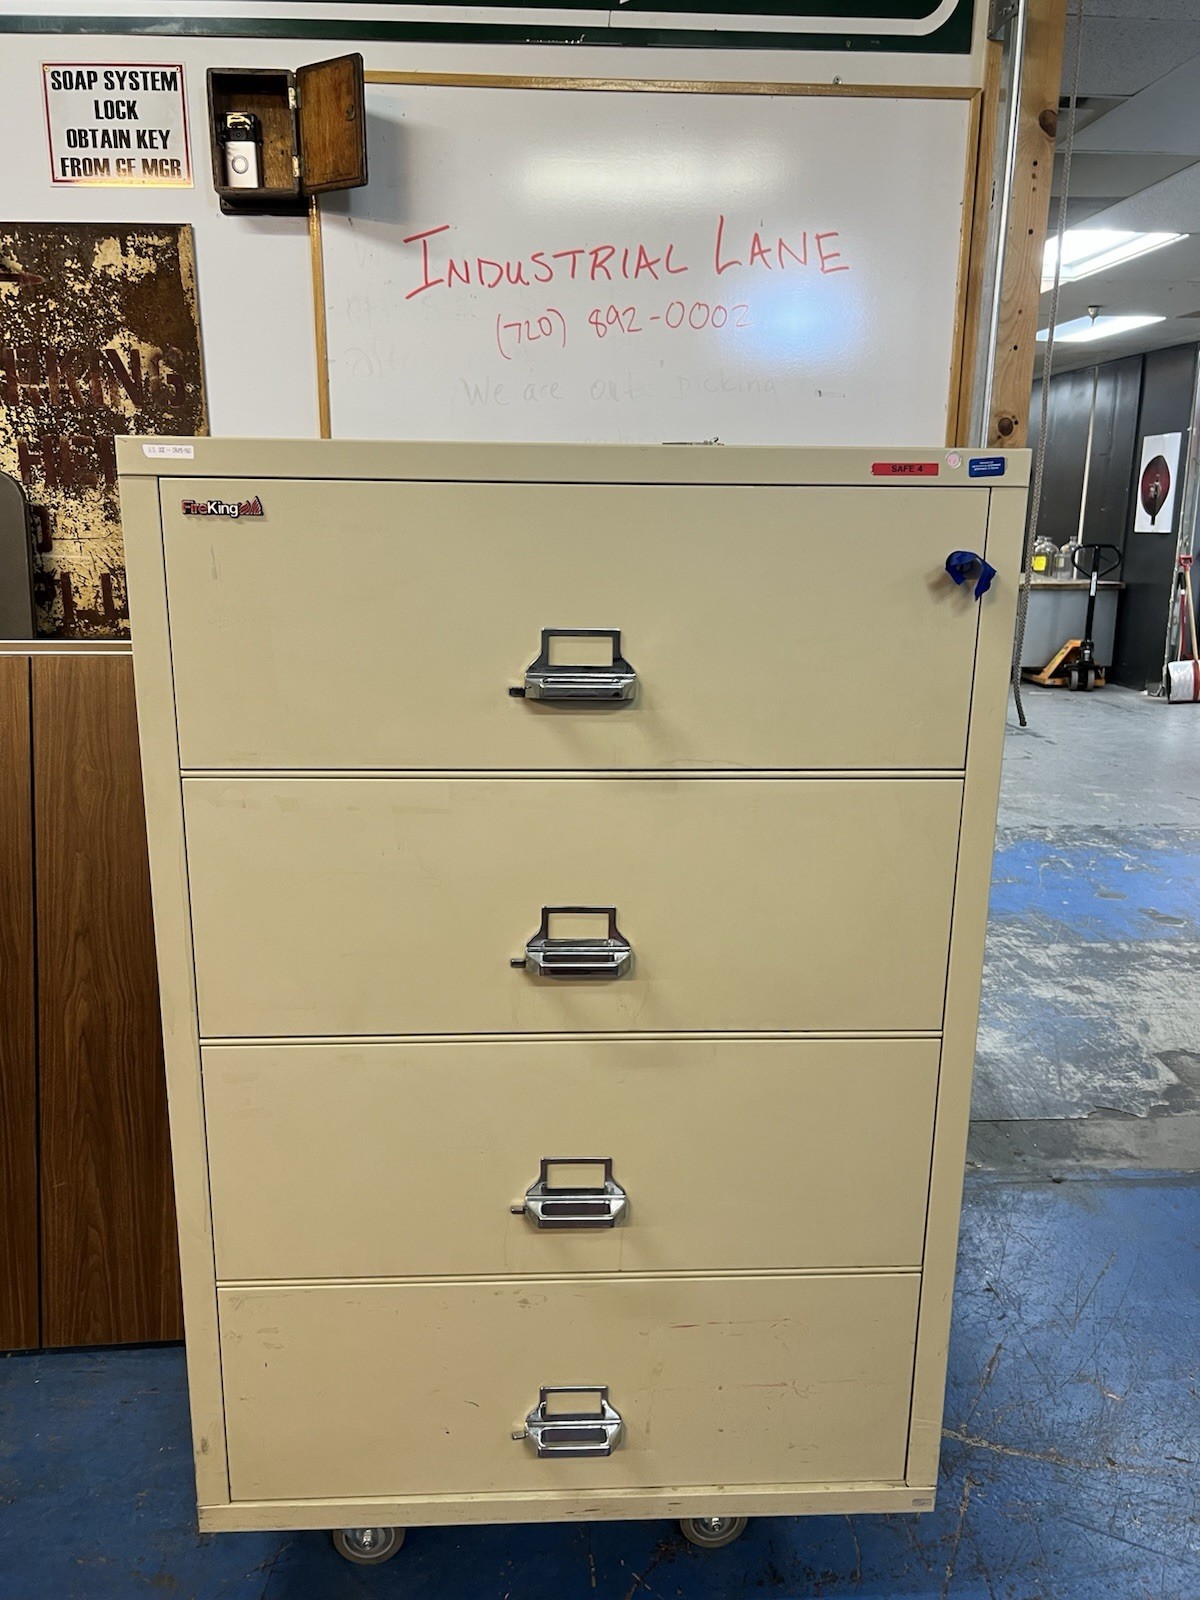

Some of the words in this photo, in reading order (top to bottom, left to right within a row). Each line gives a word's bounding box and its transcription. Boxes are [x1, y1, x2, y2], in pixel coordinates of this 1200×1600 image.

[51, 70, 98, 92] SOAP
[104, 69, 179, 93] SYSTEM
[94, 99, 139, 121] LOCK
[66, 128, 132, 149] OBTAIN
[136, 129, 171, 150] KEY
[60, 157, 111, 178] FROM
[142, 157, 182, 178] MGR
[403, 224, 688, 300] INDUSTRIAL
[715, 215, 850, 276] LANE
[496, 308, 567, 360] (720)
[588, 301, 755, 339] 892-0002
[891, 463, 914, 473] SAFE
[917, 464, 923, 473] 4
[181, 500, 239, 517] FireKing
